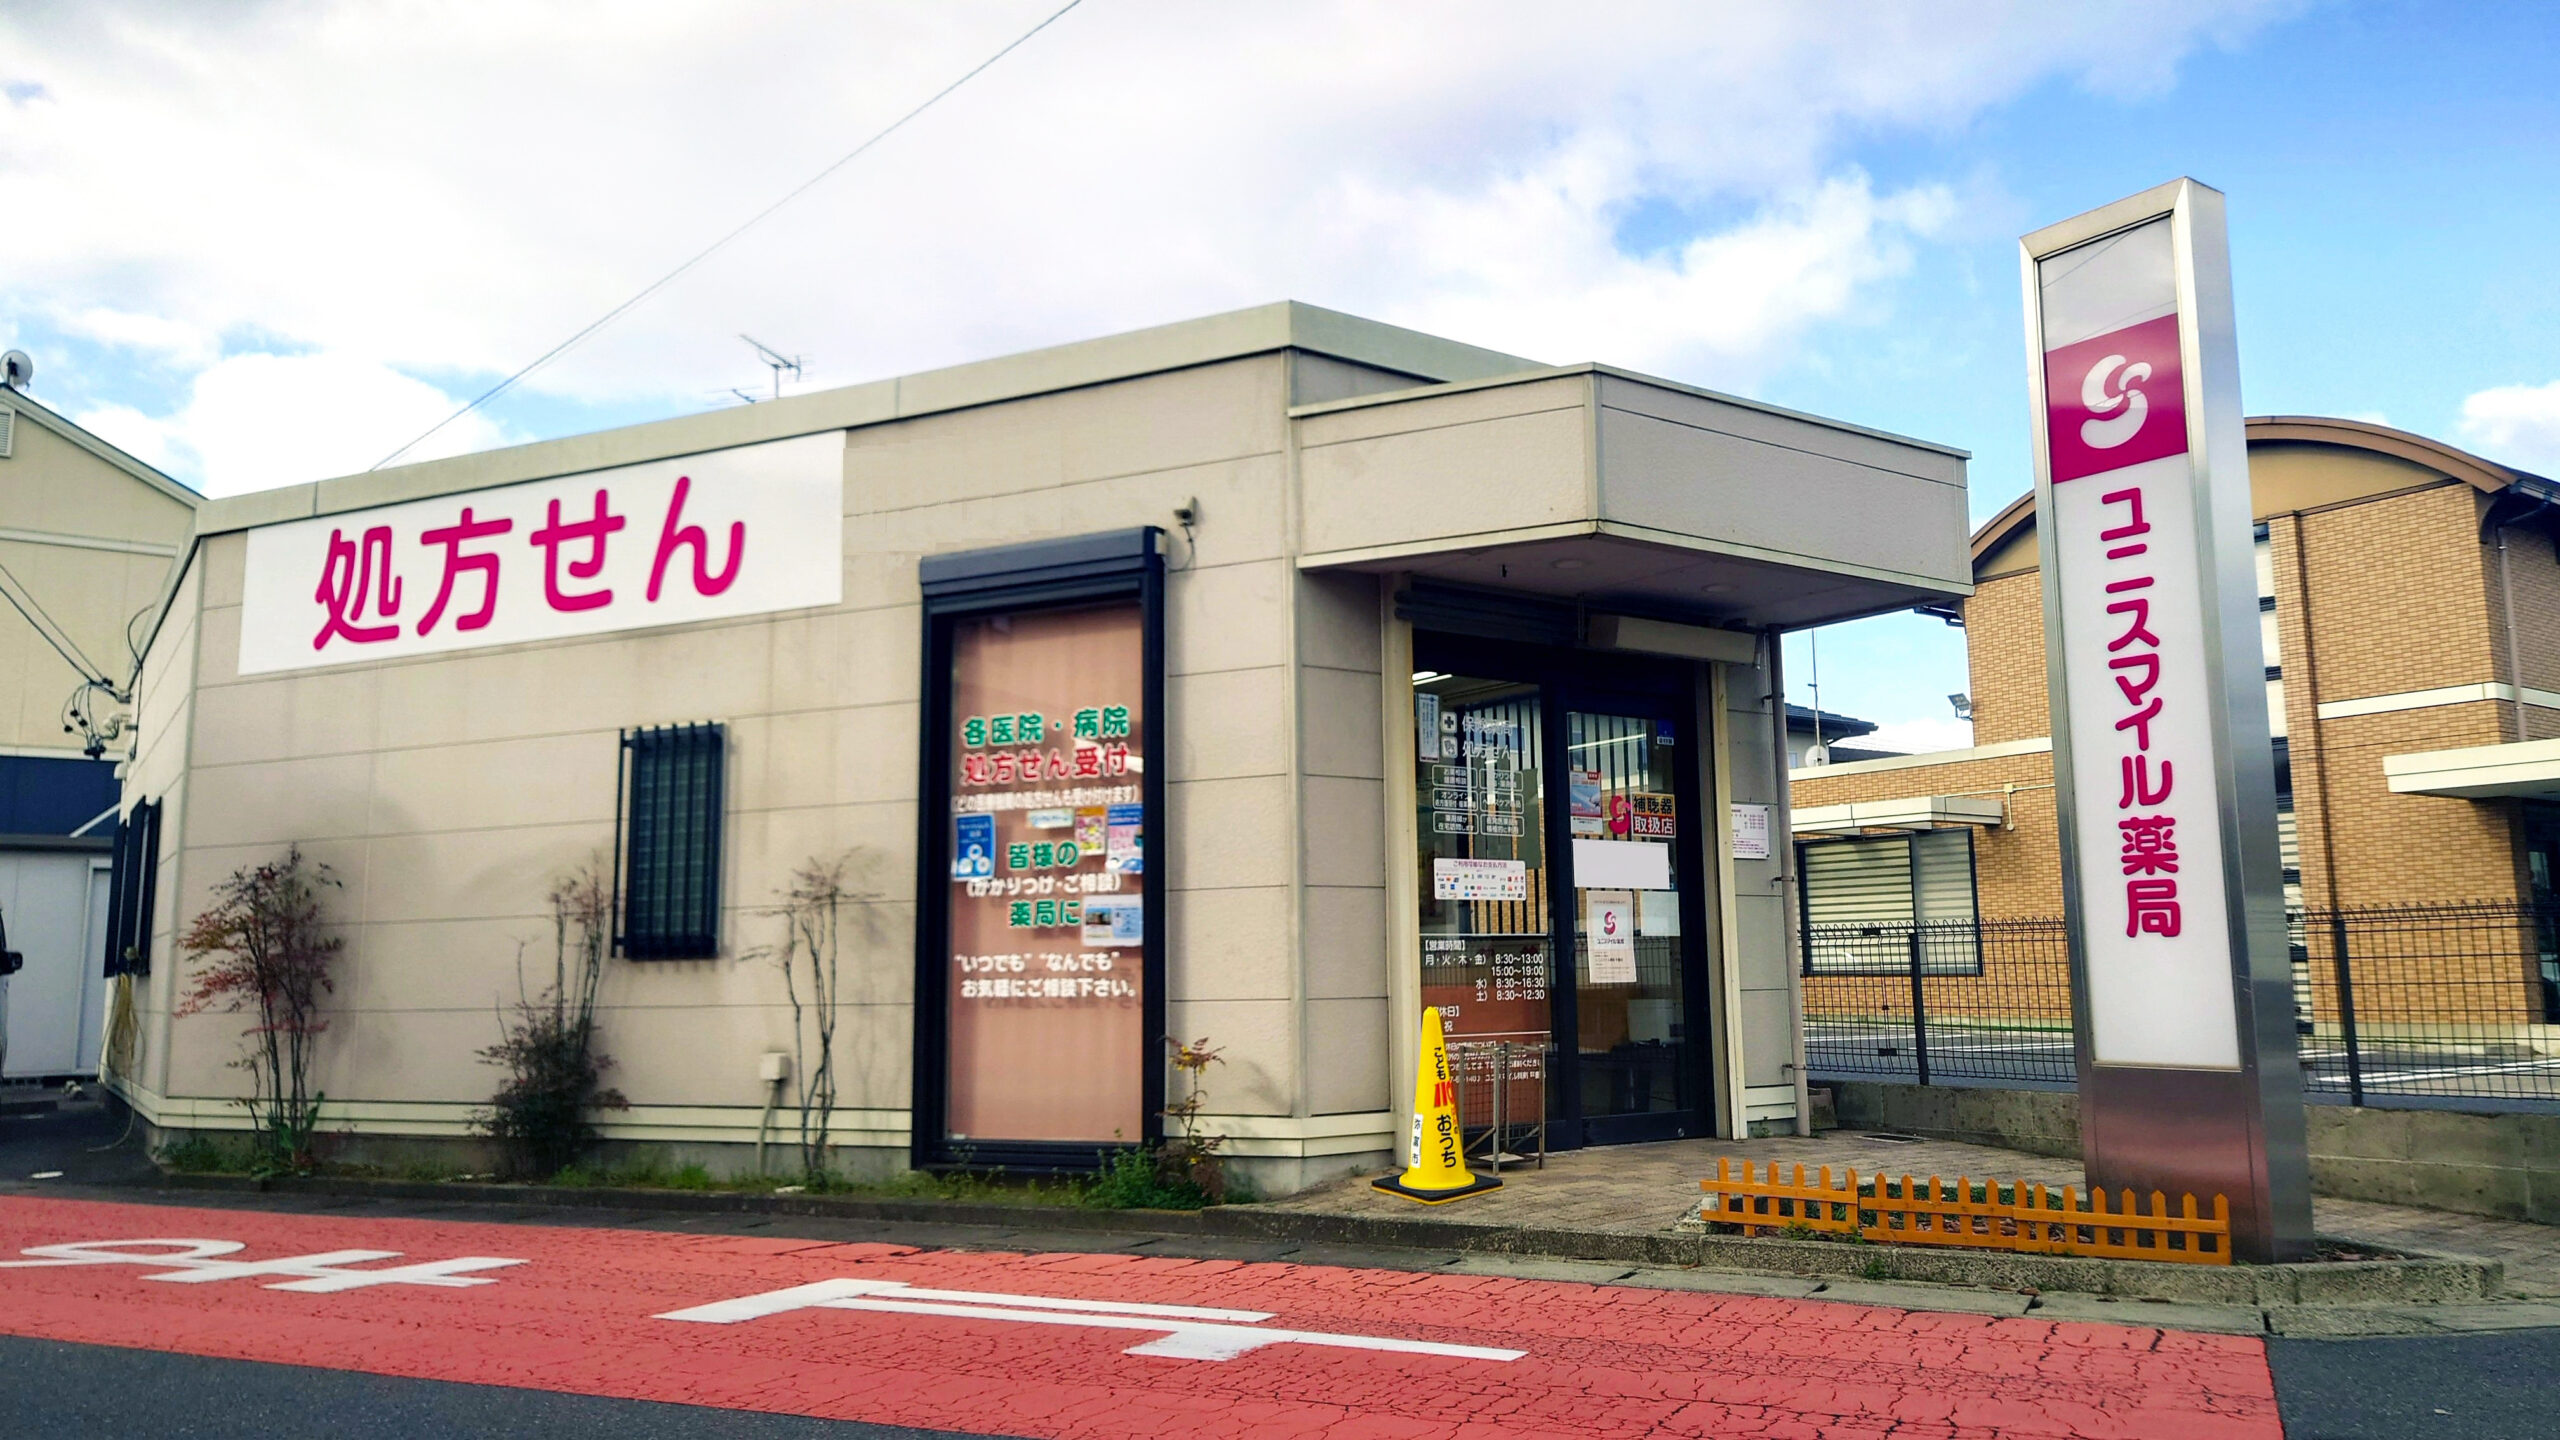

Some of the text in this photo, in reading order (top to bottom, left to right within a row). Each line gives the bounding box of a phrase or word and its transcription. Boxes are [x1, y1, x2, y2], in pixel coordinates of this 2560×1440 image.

[314, 476, 746, 651] 処方せん
[963, 706, 1130, 747] 各医院・病院
[2100, 487, 2183, 938] ユニスマイル薬局
[1462, 740, 1512, 760] 処方せん
[962, 745, 1129, 786] 処方せん受付
[1633, 795, 1673, 815] 補聴器
[1634, 816, 1674, 834] 取扱店
[1008, 842, 1080, 870] 皆様の
[1009, 900, 1082, 928] 薬局に
[1425, 940, 1465, 951] 【営業時間】
[1436, 1115, 1457, 1168] おうち
